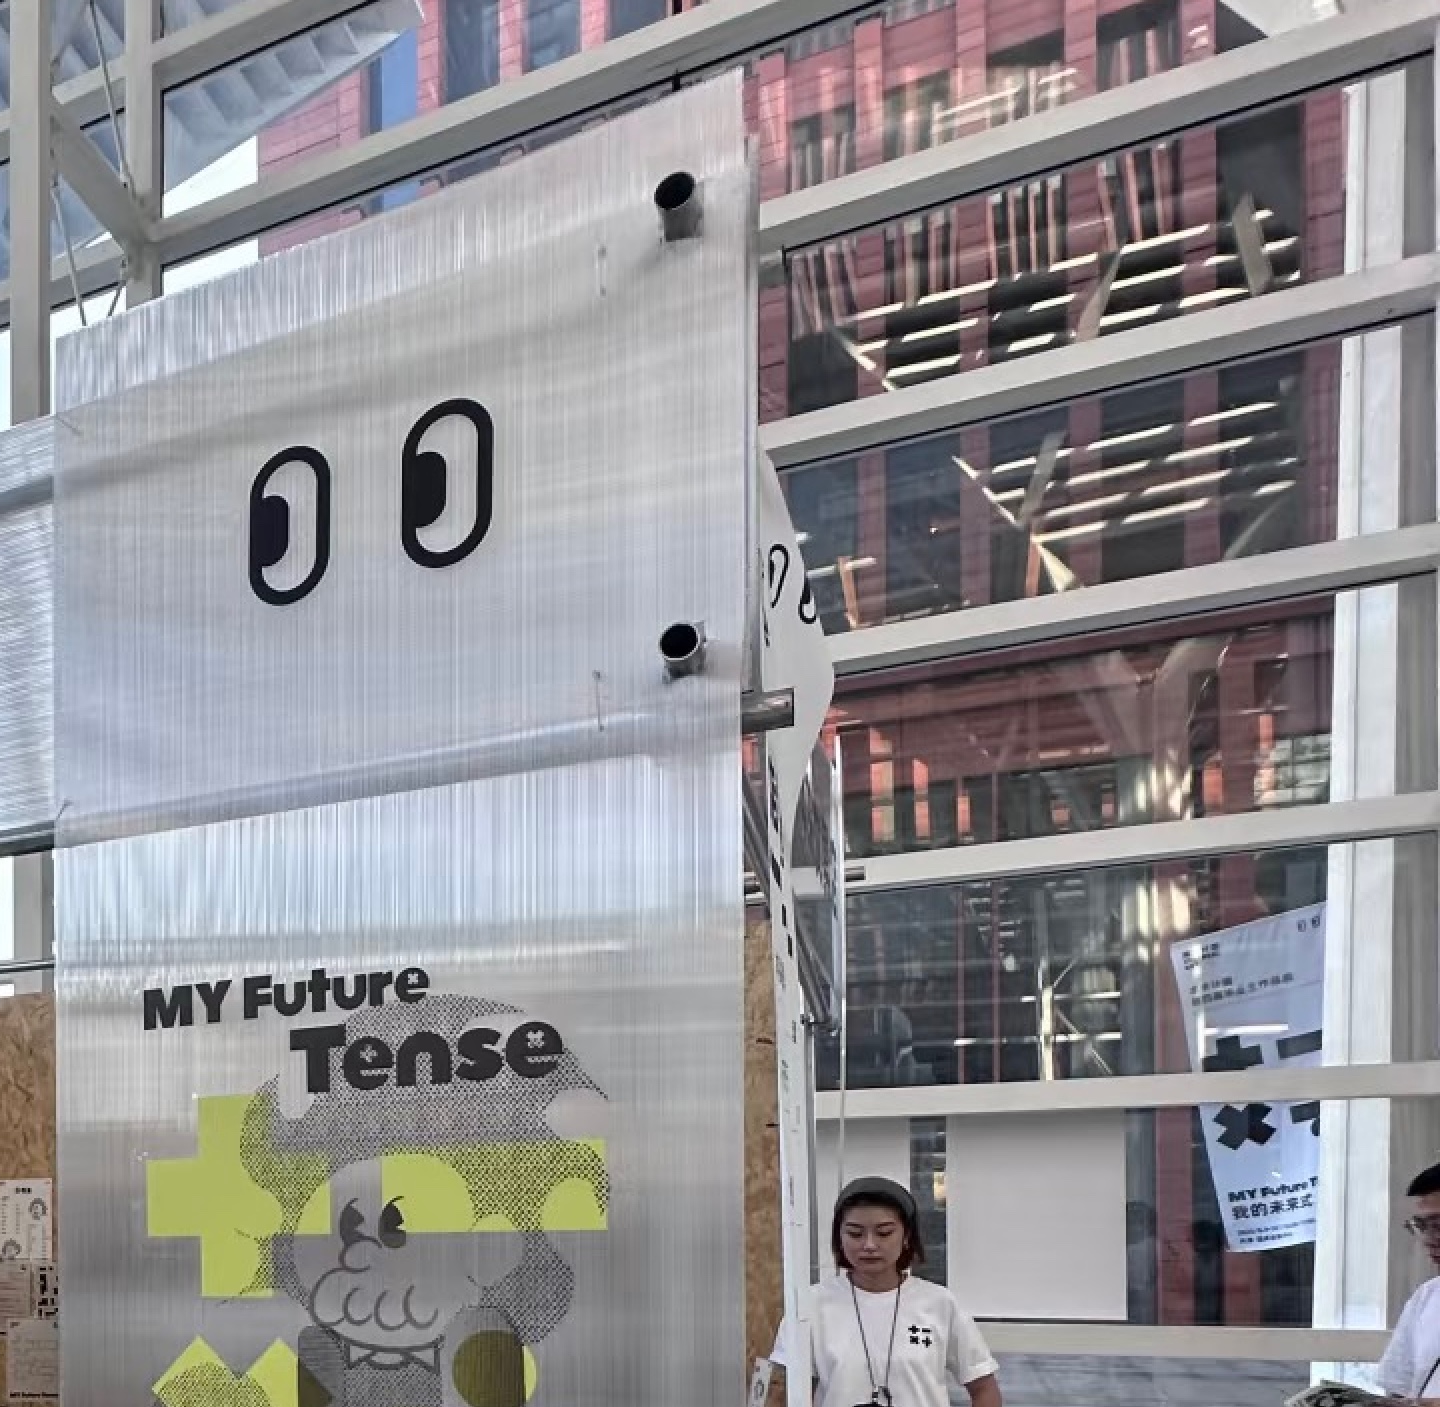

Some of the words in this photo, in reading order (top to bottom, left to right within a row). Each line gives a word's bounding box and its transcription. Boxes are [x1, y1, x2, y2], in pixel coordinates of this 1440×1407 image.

[143, 979, 231, 1030] MY
[243, 967, 429, 1018] Future
[290, 1021, 563, 1093] Tense
